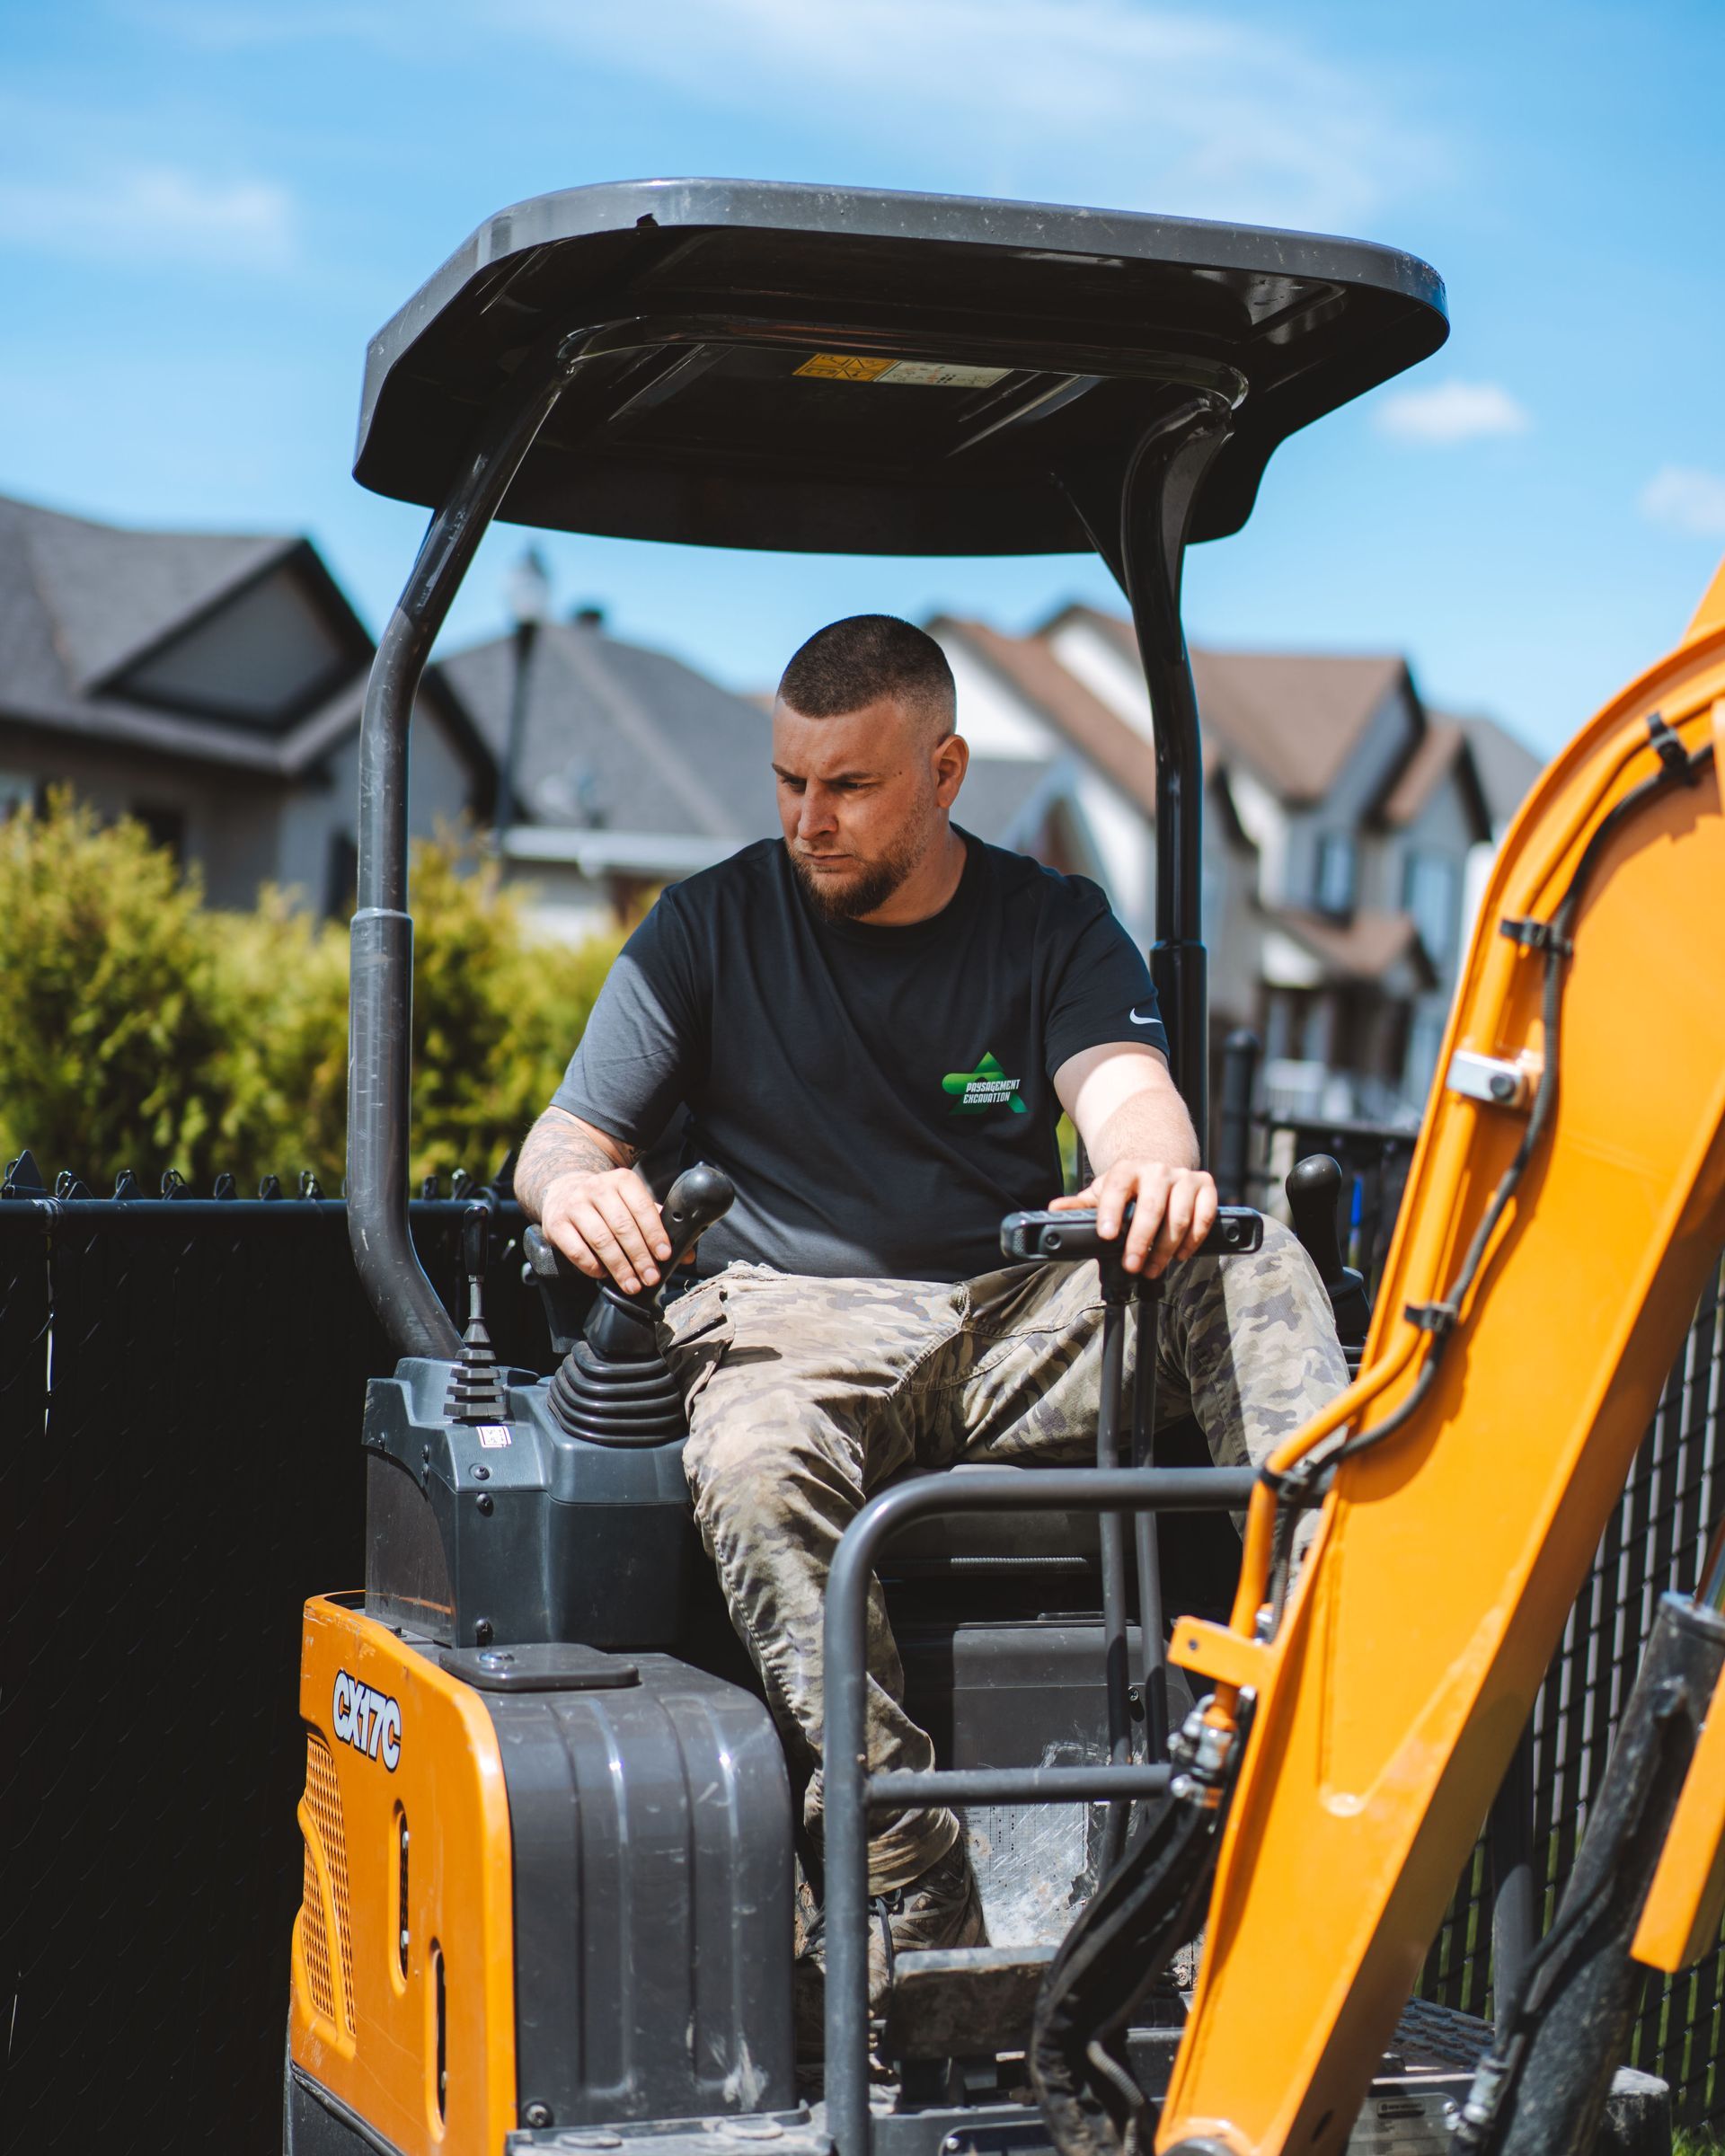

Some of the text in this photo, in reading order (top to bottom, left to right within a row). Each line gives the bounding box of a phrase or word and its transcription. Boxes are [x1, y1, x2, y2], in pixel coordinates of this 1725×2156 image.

[966, 1079, 1021, 1092] PAYSAGEMENT
[963, 1091, 1011, 1104] EXCAVATION
[332, 1669, 402, 1773] CX17C
